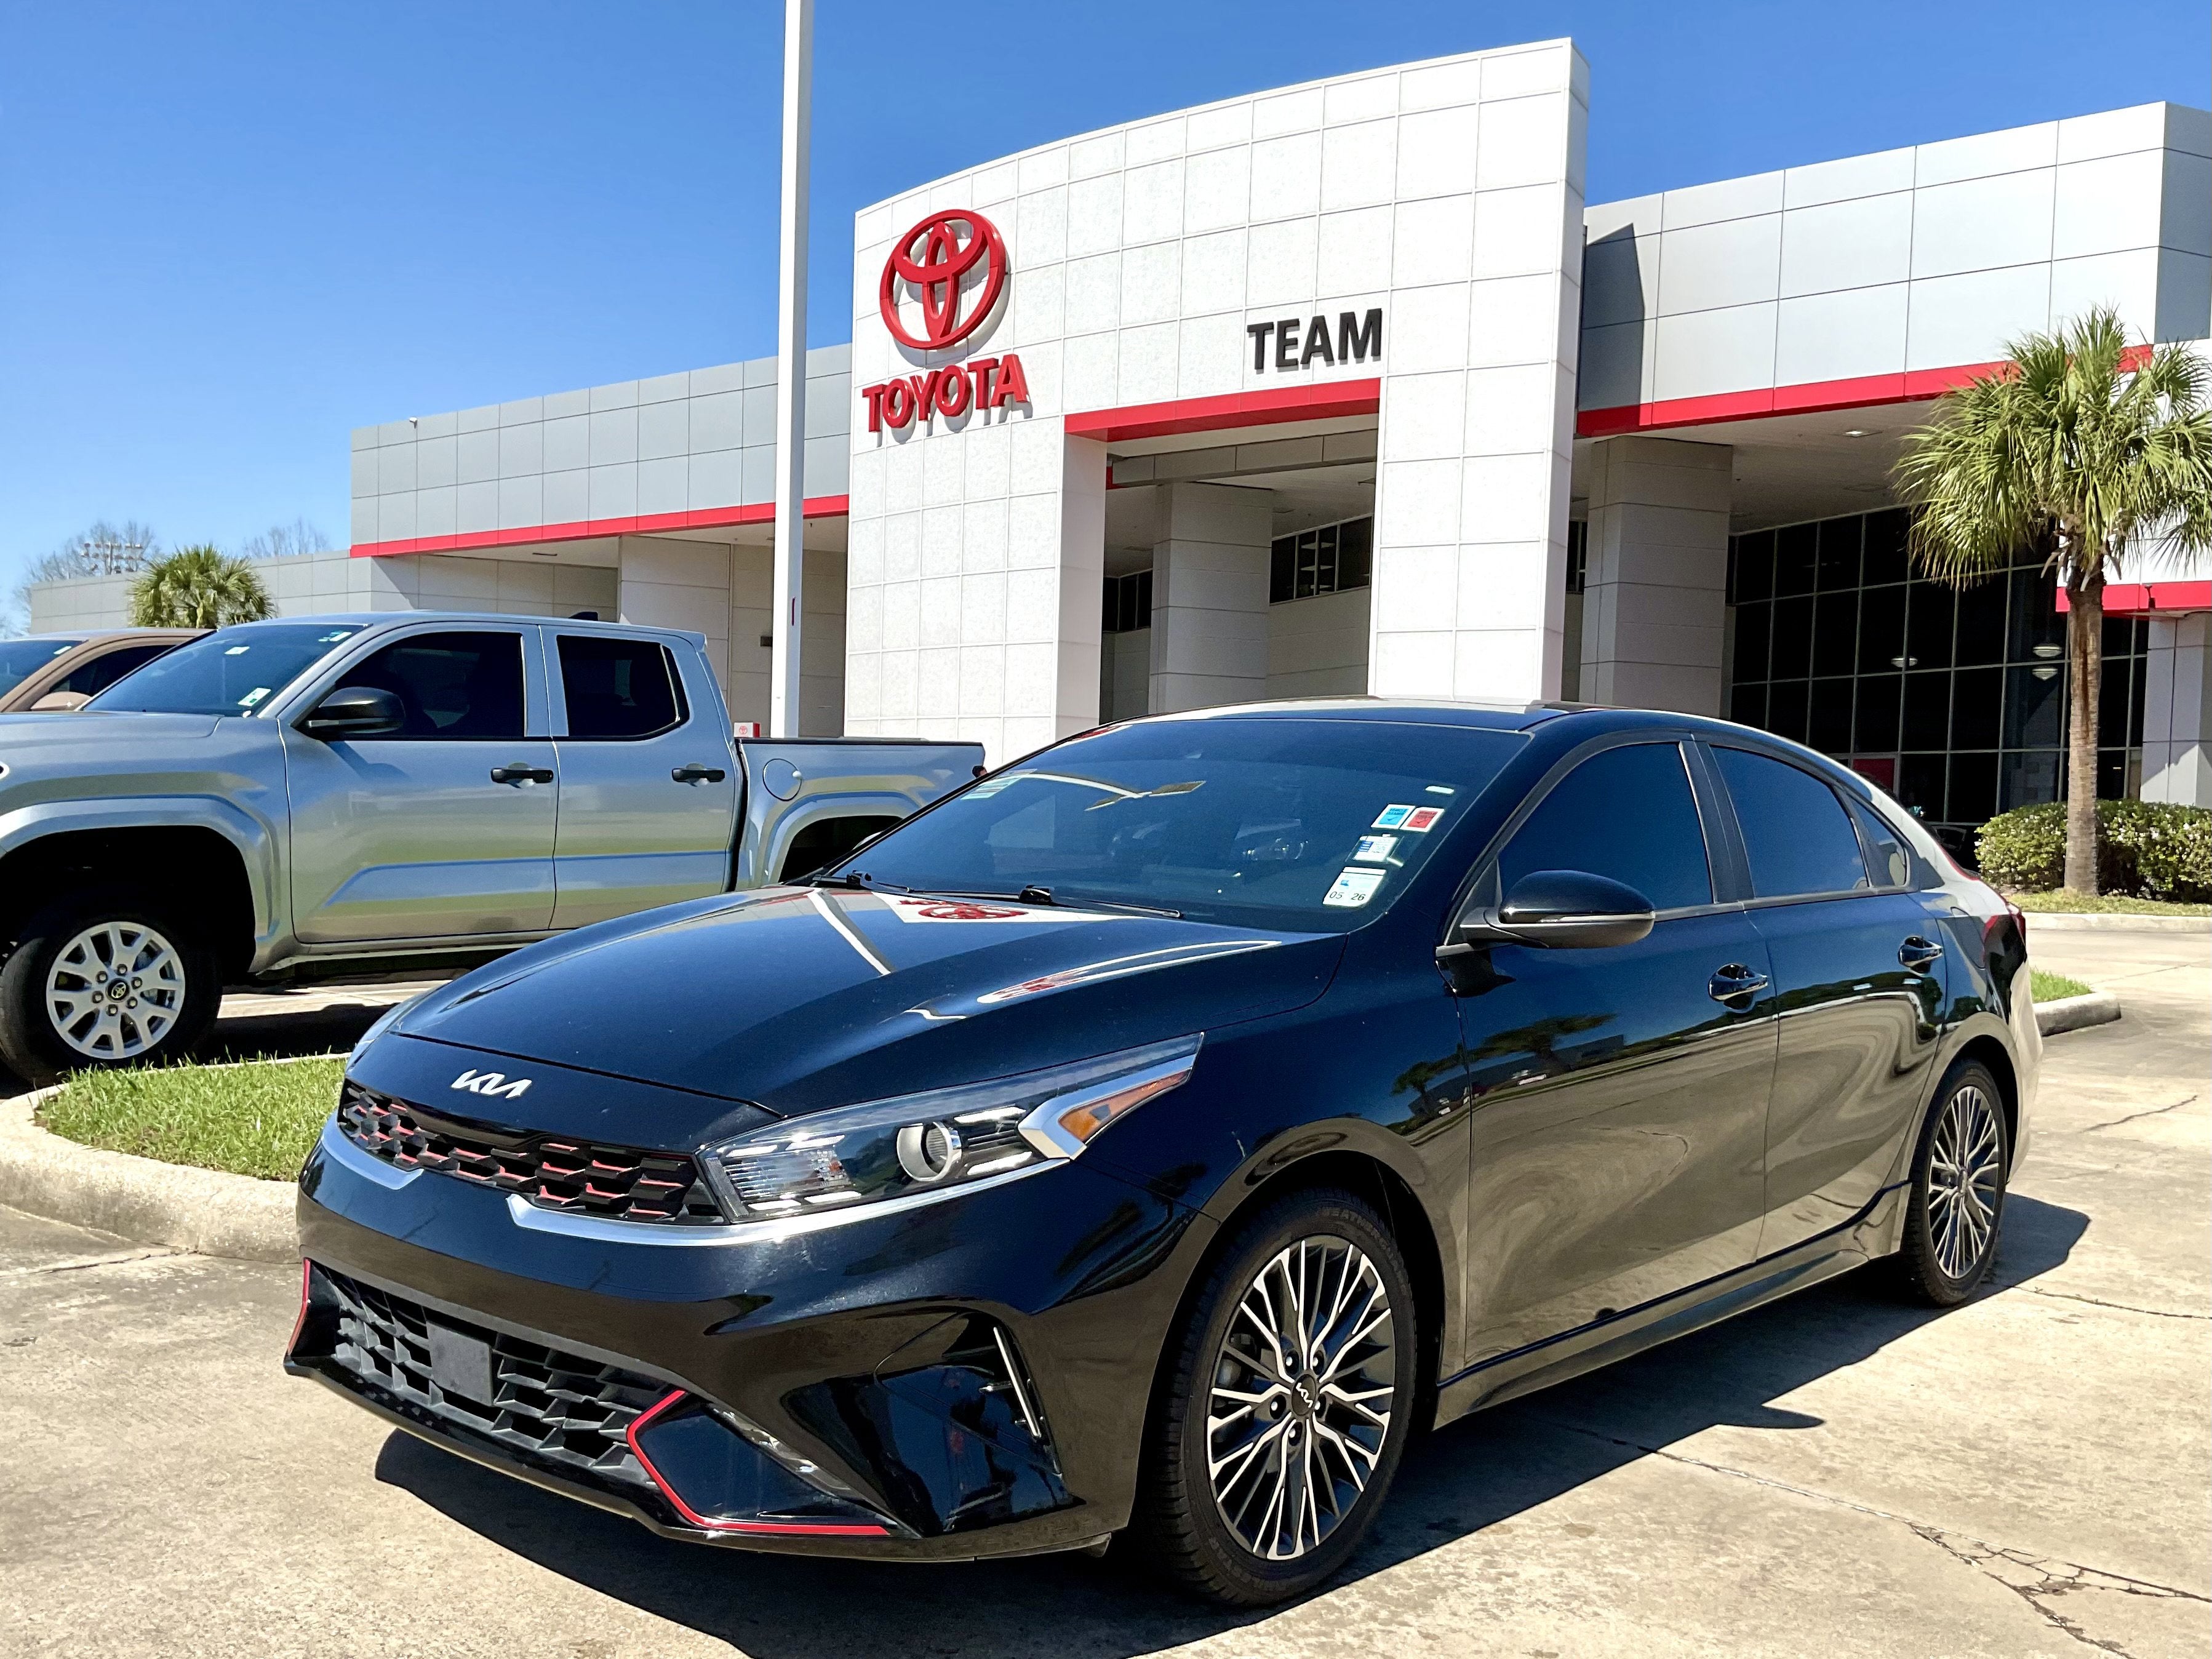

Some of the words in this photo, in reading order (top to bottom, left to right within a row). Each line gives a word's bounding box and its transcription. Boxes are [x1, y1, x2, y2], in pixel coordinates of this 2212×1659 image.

[1247, 308, 1382, 370] TEAM
[863, 354, 1029, 433] TOYOTA
[451, 1069, 532, 1099] KIA
